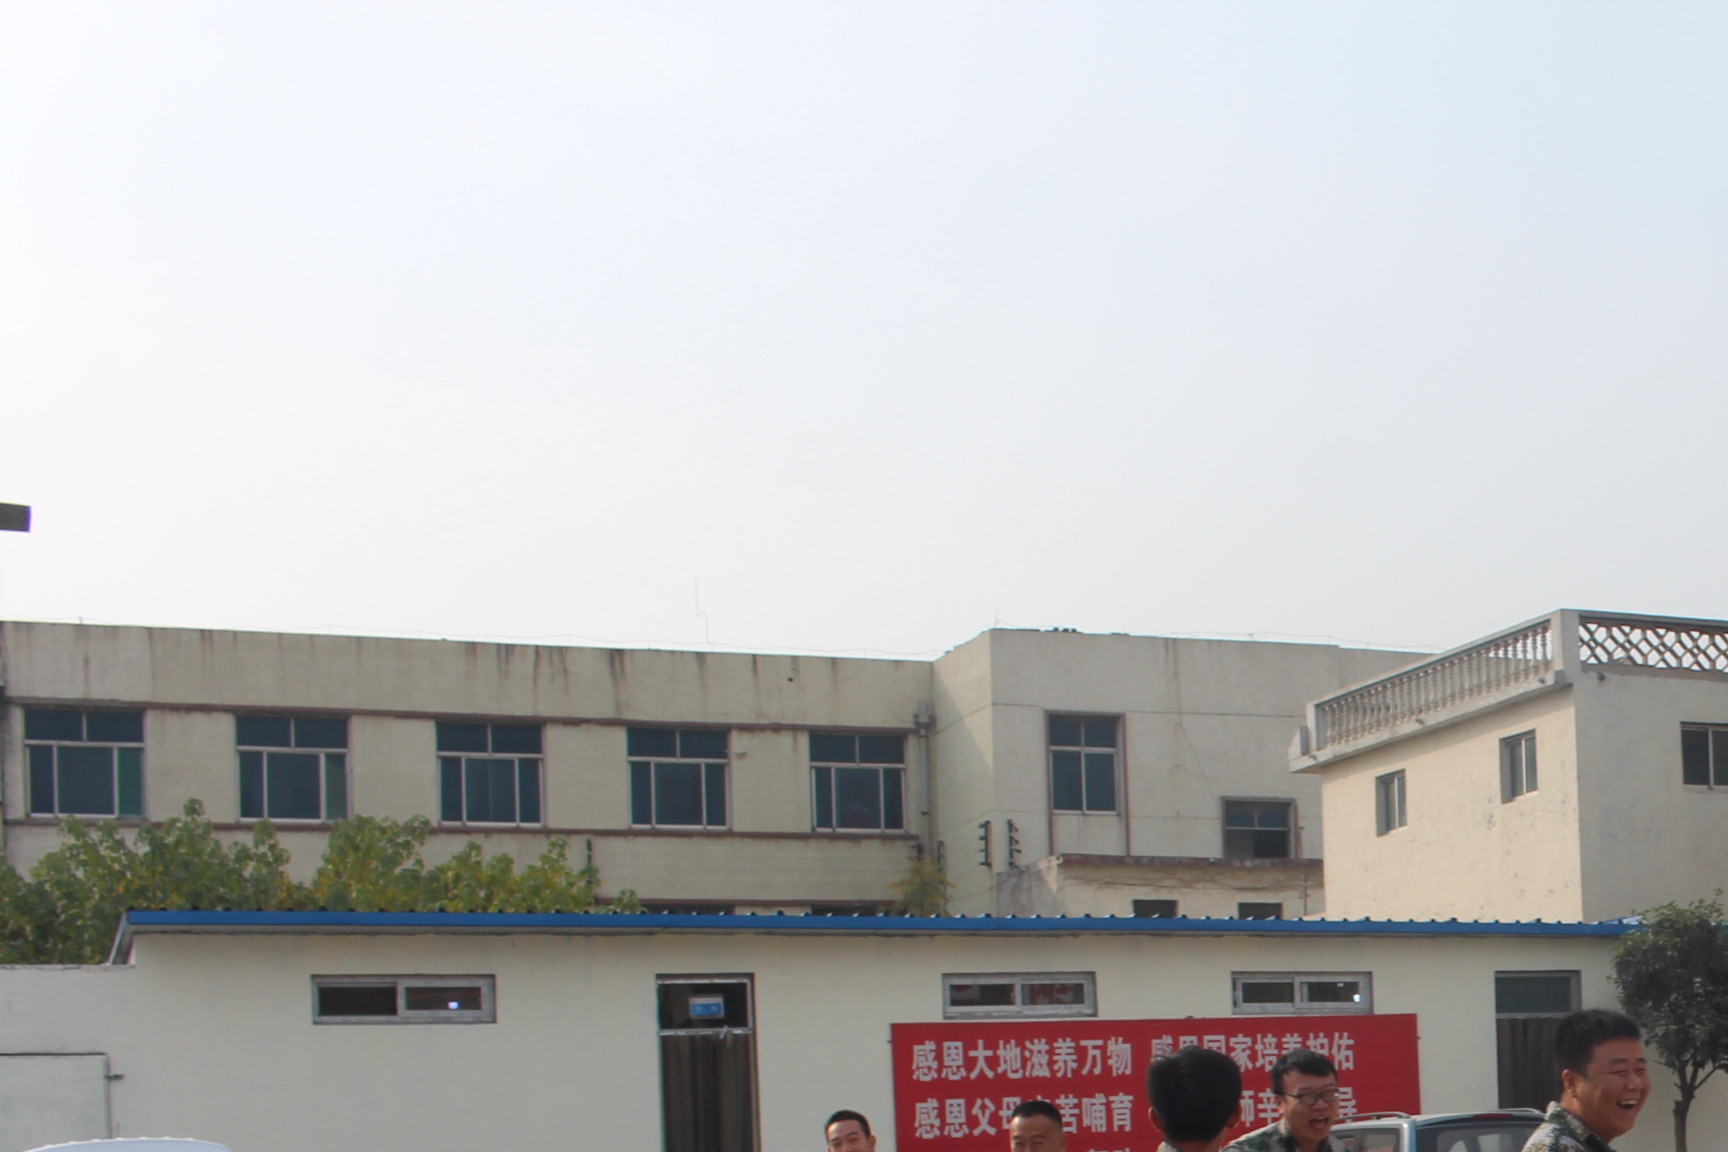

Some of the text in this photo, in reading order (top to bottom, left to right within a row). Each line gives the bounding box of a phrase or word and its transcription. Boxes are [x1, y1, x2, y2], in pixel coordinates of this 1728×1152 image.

[911, 1036, 1132, 1082] 感恩大地滋养万物
[914, 1092, 1135, 1139] 感恩父母苦哺育
